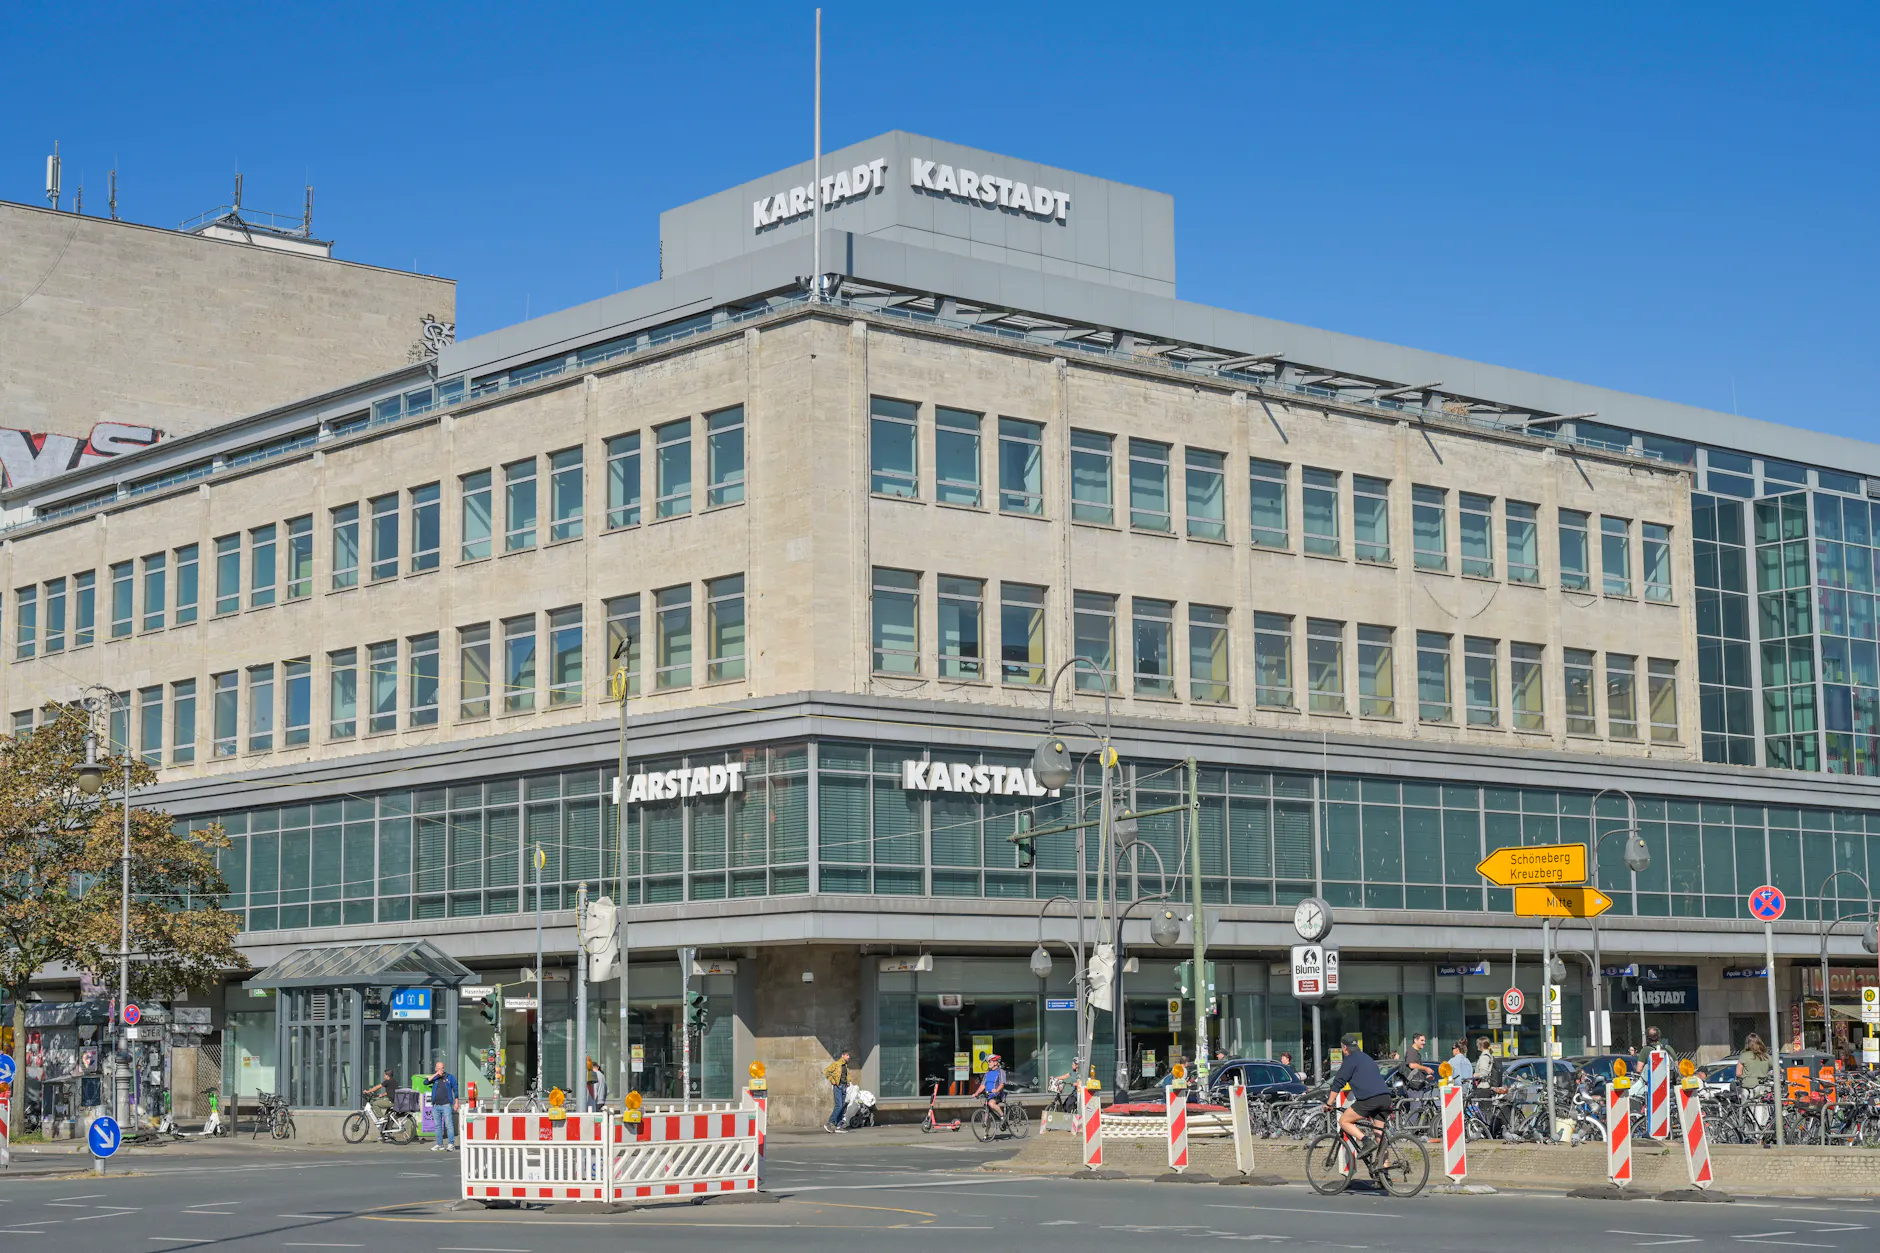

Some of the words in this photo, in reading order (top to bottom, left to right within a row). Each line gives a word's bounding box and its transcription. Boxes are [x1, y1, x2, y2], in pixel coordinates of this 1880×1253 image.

[754, 157, 888, 228] KARSTADT
[911, 157, 1070, 220] KARSTADT
[902, 759, 1061, 798] KARSTAD
[1510, 853, 1570, 865] Schöneberg
[1510, 868, 1563, 880] Kreuzberg
[1546, 897, 1573, 908] Mitte
[1295, 965, 1320, 975] Blume
[1814, 969, 1879, 992] Mevlan
[395, 993, 404, 1005] U
[1507, 995, 1520, 1007] 30
[1631, 991, 1686, 1004] KARSTADT
